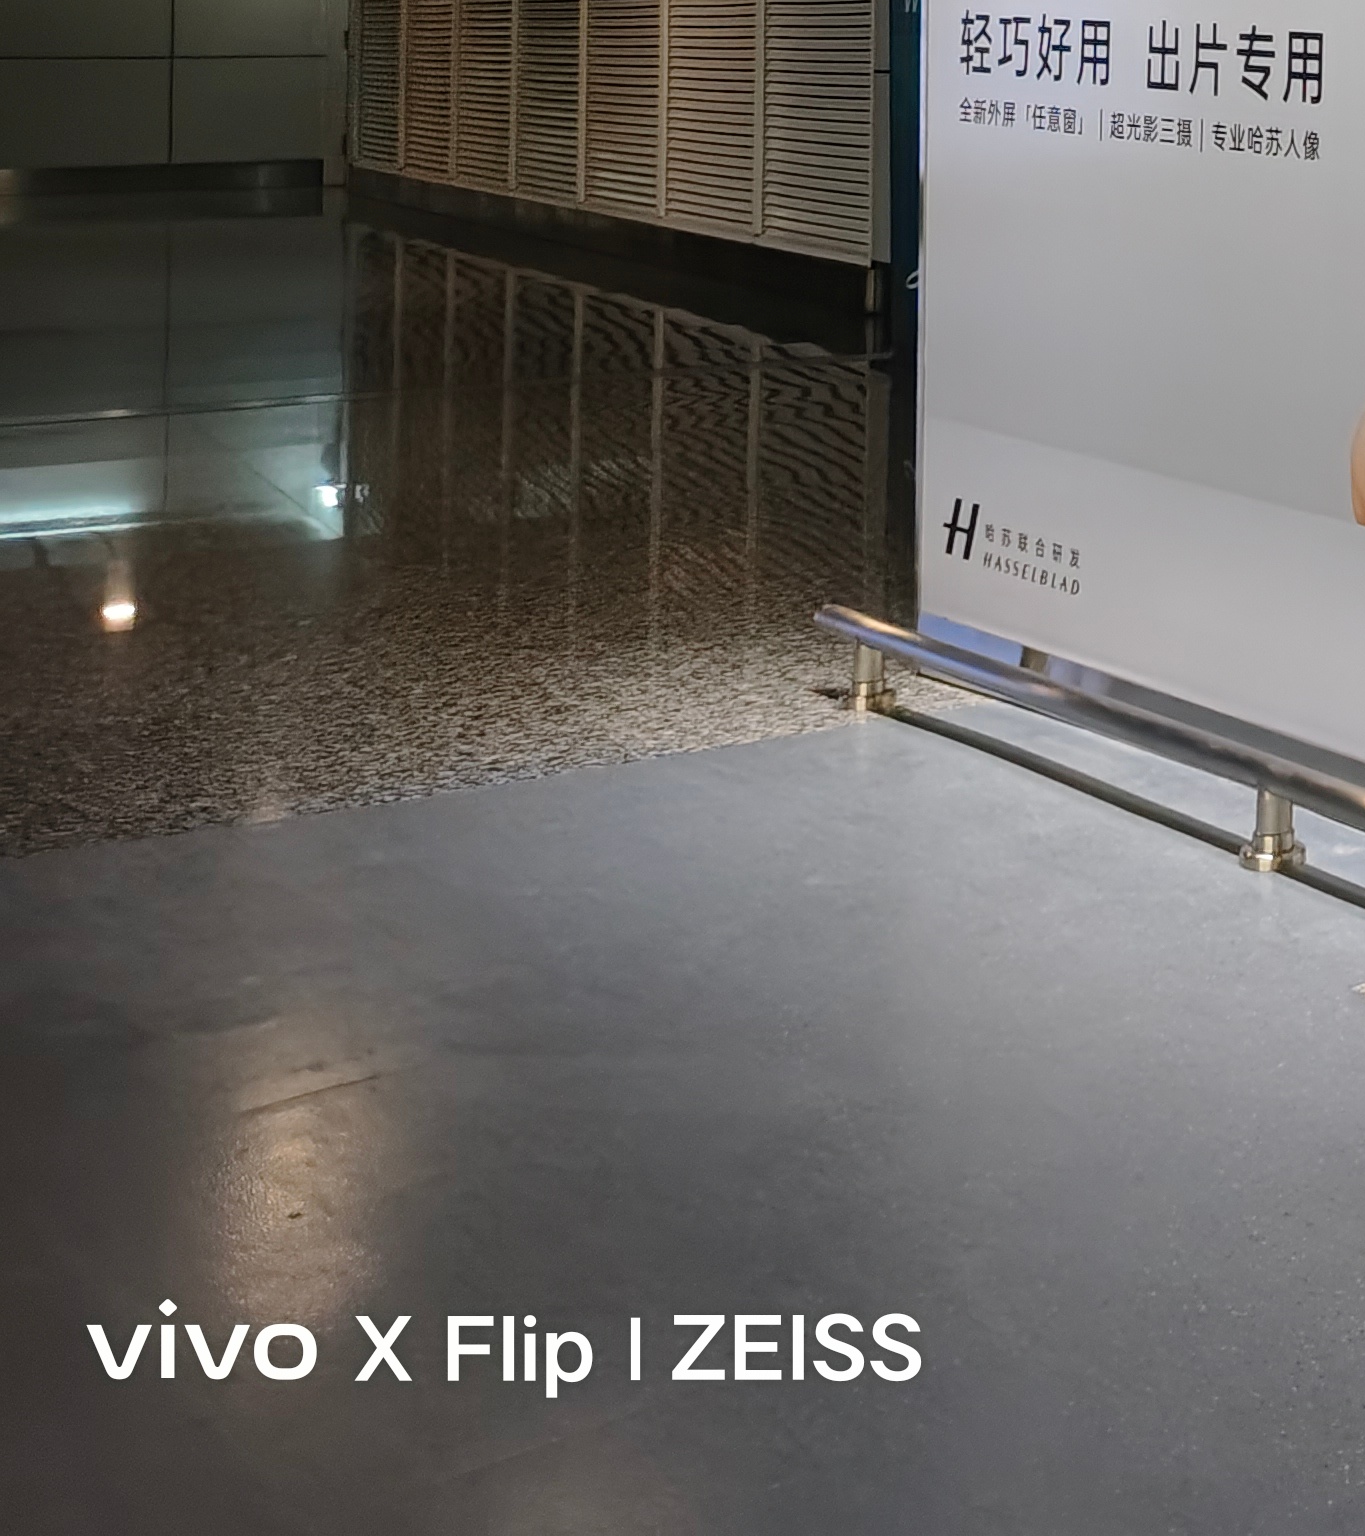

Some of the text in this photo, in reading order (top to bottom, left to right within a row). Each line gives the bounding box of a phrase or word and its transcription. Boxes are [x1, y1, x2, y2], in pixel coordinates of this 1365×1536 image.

[959, 9, 1324, 104] 轻巧好用 出片专用
[1109, 112, 1193, 148] 超光影三摄
[1211, 121, 1320, 161] 专业哈苏人像
[983, 552, 1081, 595] HASSELBLAD
